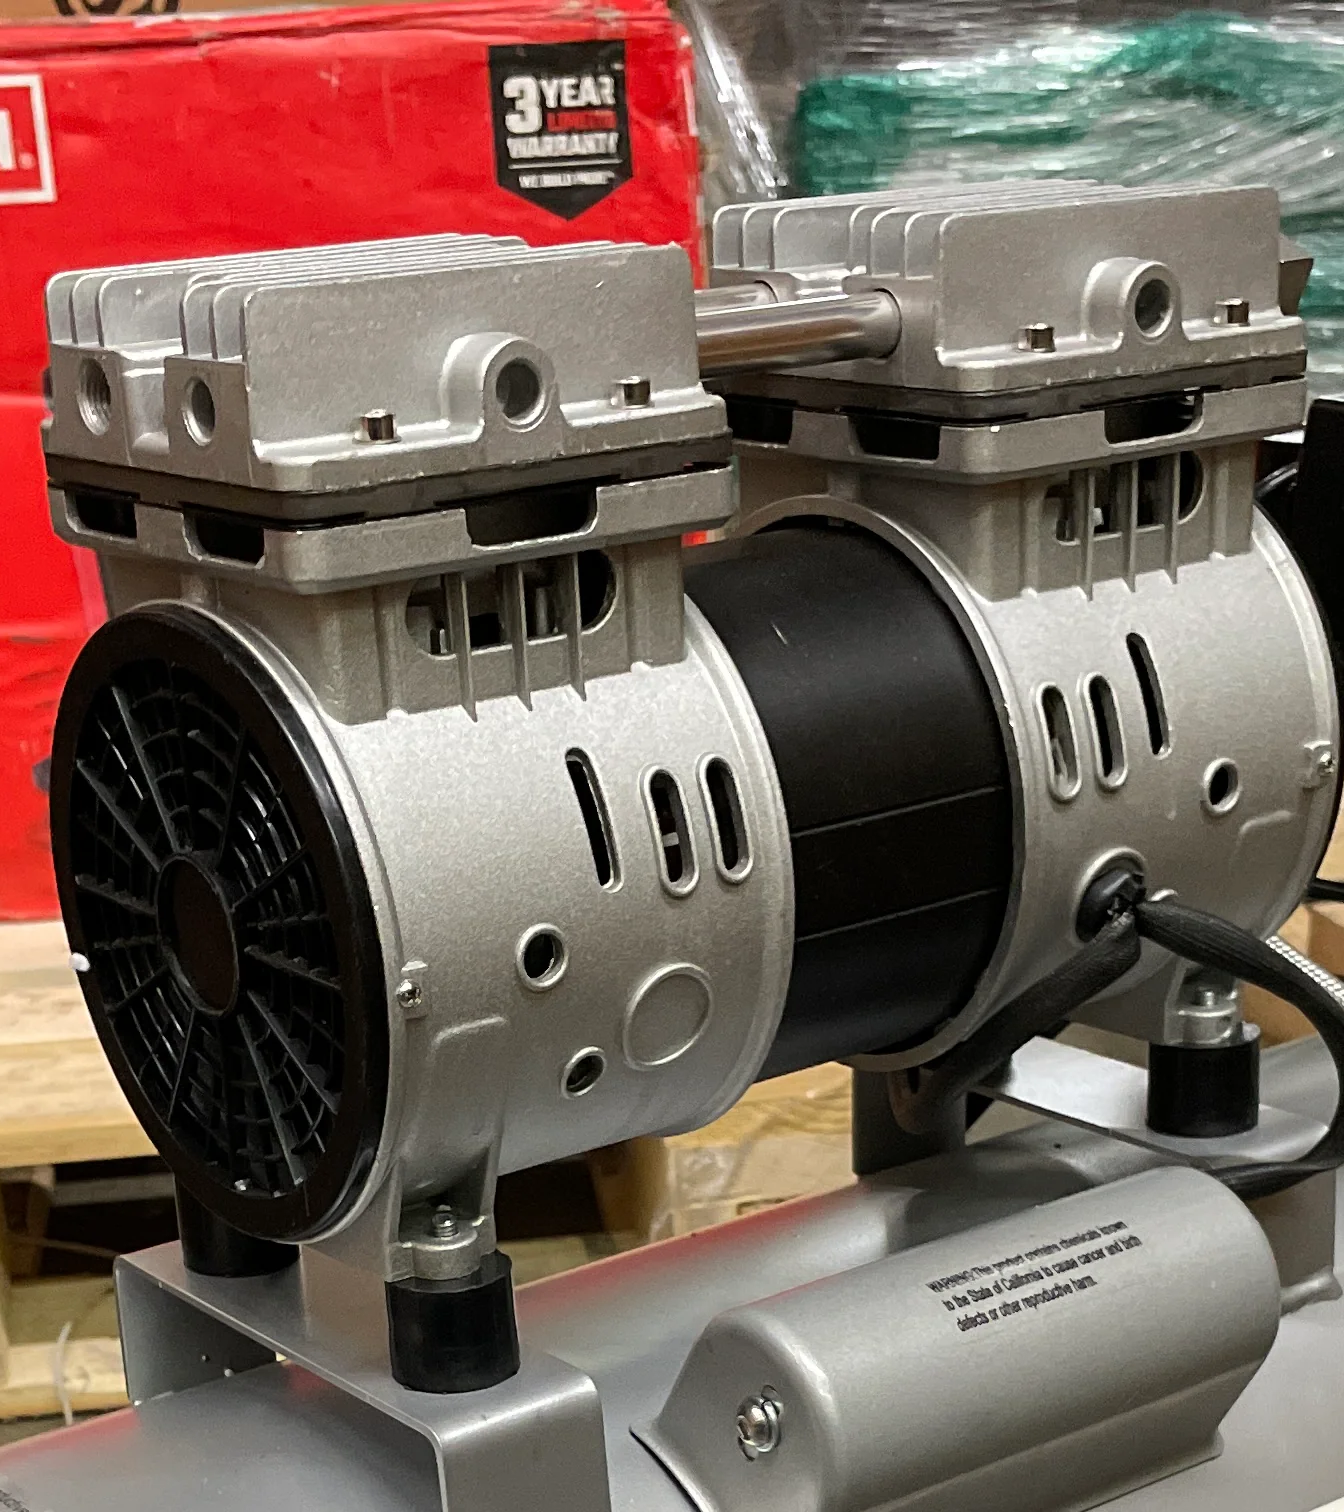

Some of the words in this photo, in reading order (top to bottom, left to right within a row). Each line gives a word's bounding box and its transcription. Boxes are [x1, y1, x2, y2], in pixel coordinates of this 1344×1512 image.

[503, 75, 543, 134] 3
[540, 73, 616, 109] YEAR
[506, 132, 619, 159] WARRANTY
[941, 1300, 956, 1312] to
[951, 1295, 971, 1308] the
[966, 1287, 994, 1303] State
[992, 1280, 1003, 1295] of
[1000, 1270, 1044, 1291] California
[1039, 1266, 1054, 1278] to
[1051, 1258, 1079, 1274] cause
[1077, 1248, 1106, 1265] cancer
[1104, 1239, 1124, 1256] and
[957, 1312, 990, 1332] defects
[988, 1308, 999, 1321] or
[998, 1300, 1022, 1317] other
